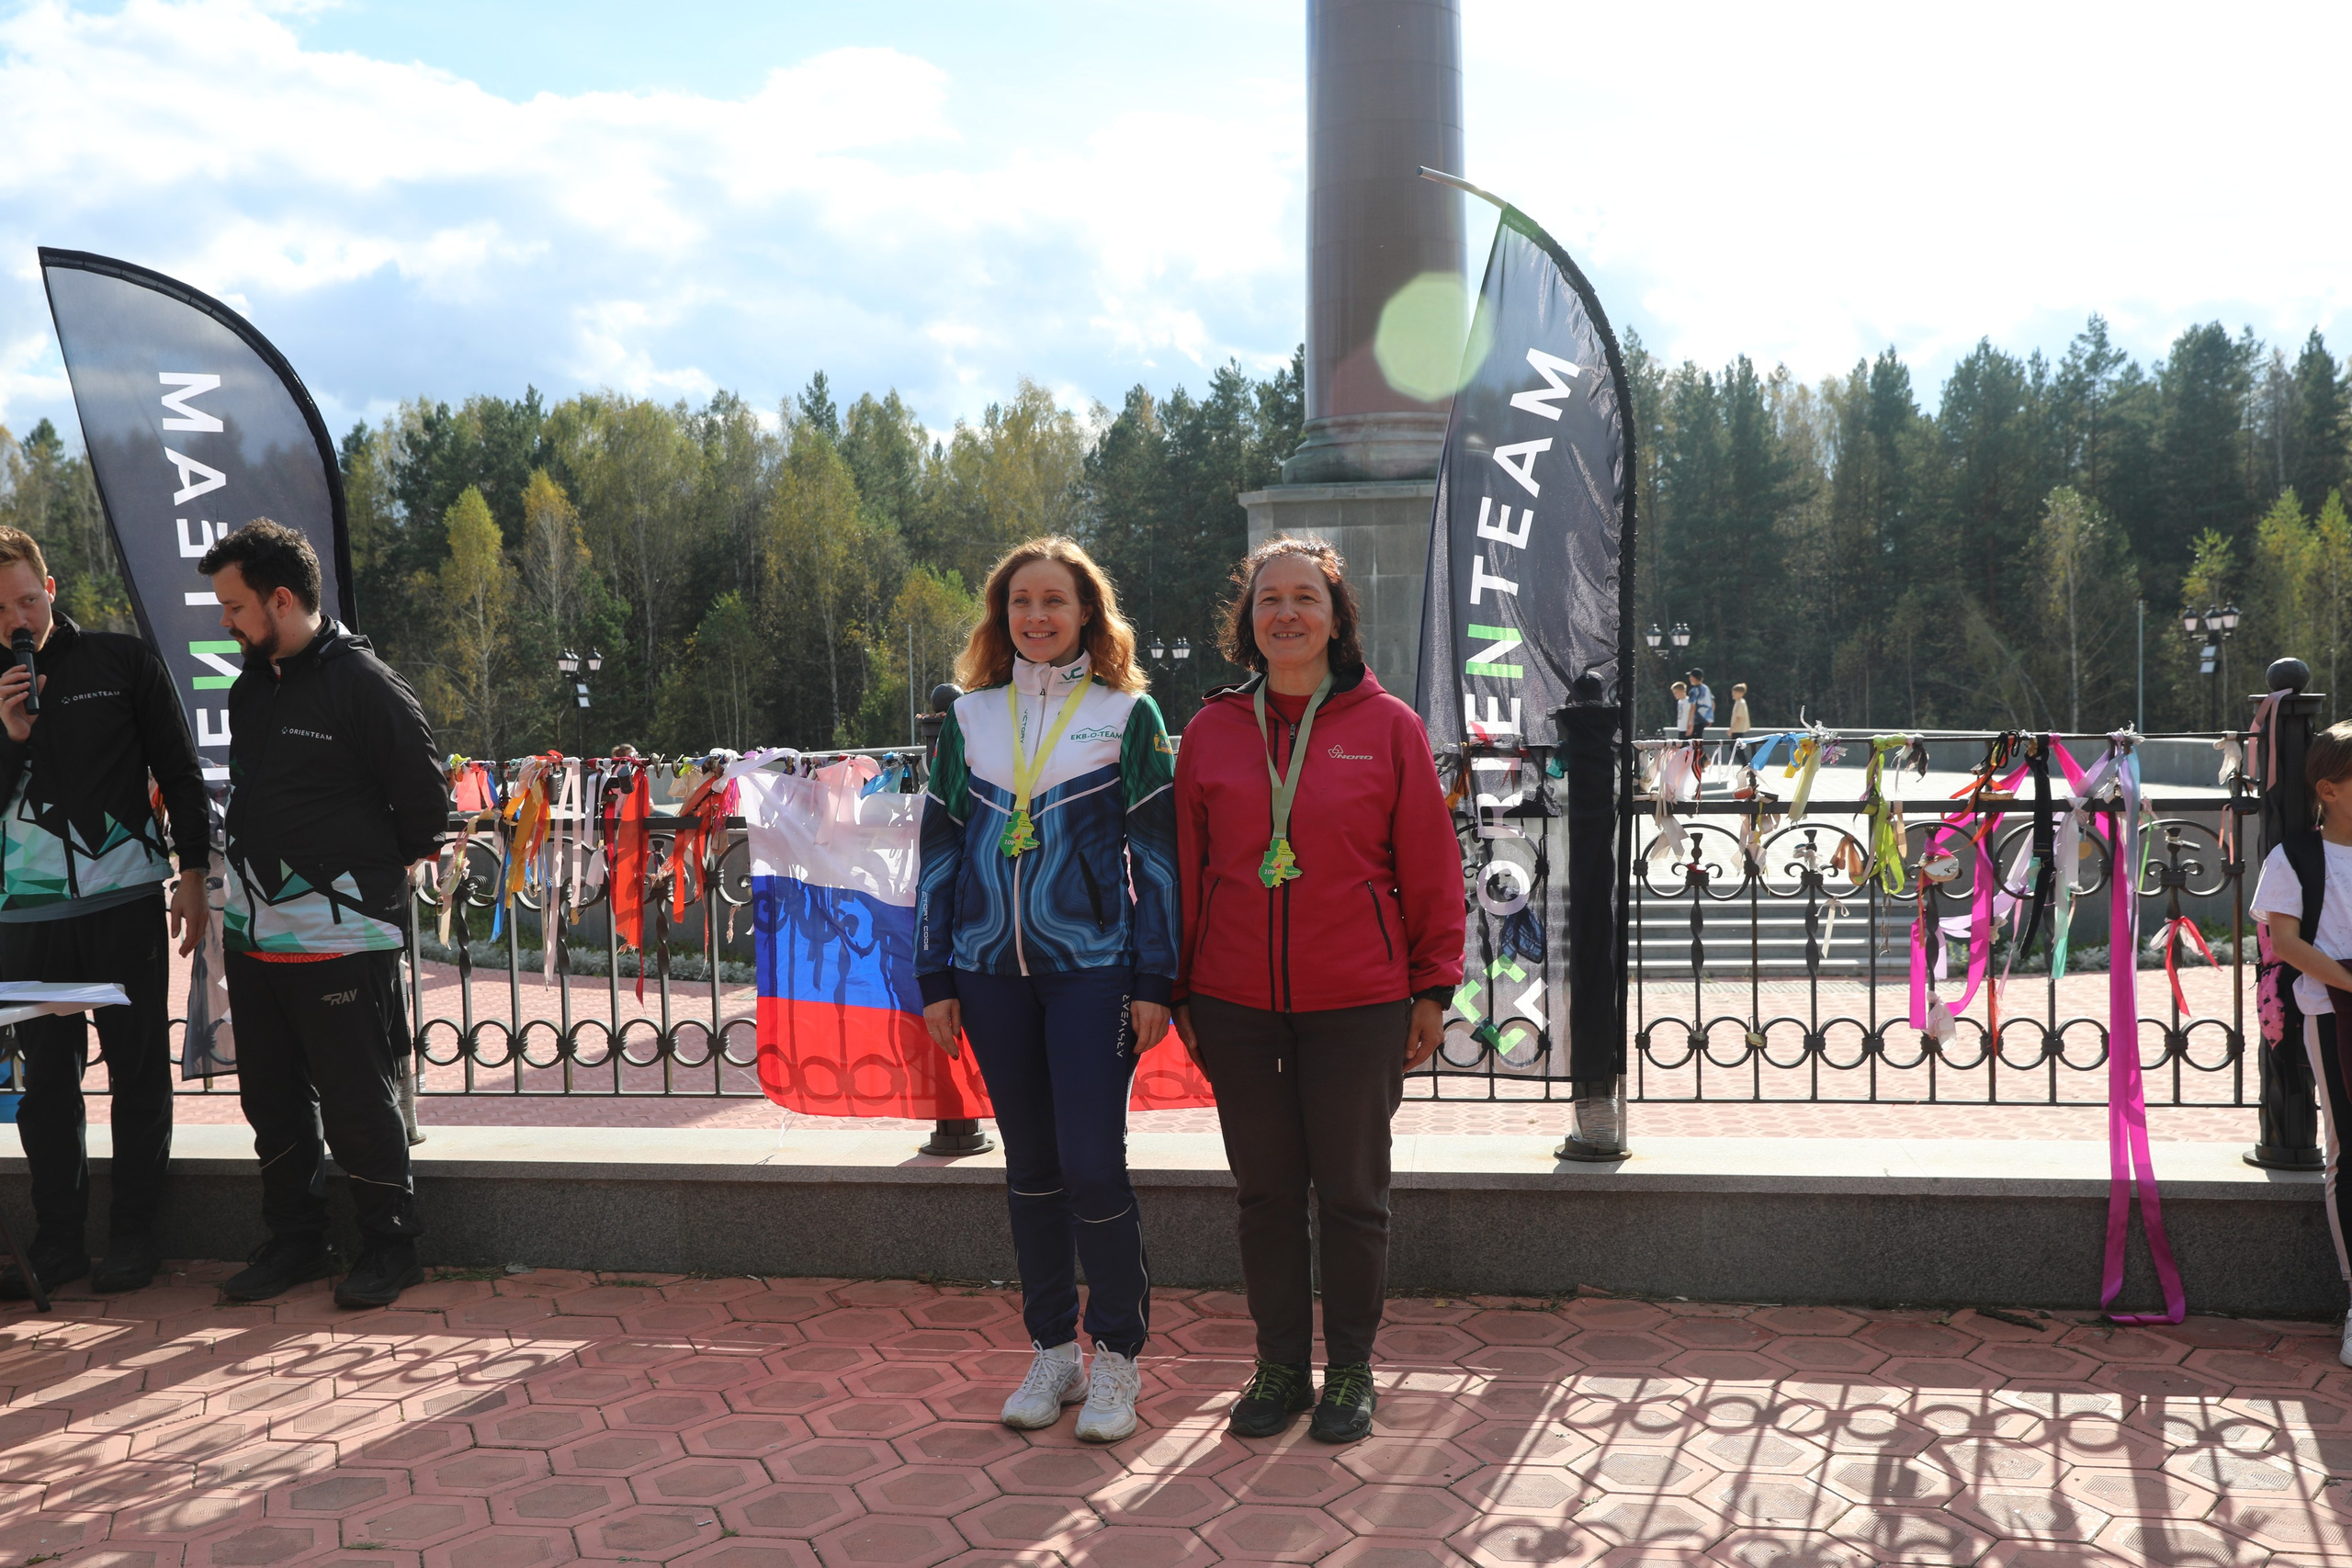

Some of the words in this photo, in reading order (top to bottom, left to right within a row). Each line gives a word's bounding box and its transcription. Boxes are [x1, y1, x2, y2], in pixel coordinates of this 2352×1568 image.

[1465, 346, 1581, 917] ORIENTEAM
[73, 691, 120, 701] ORIENTEAM
[288, 728, 333, 741] ORIENTEAM
[1020, 708, 1029, 744] VICTORY
[1070, 730, 1123, 740] EKB-O-TEAM
[921, 891, 929, 921] CTORY
